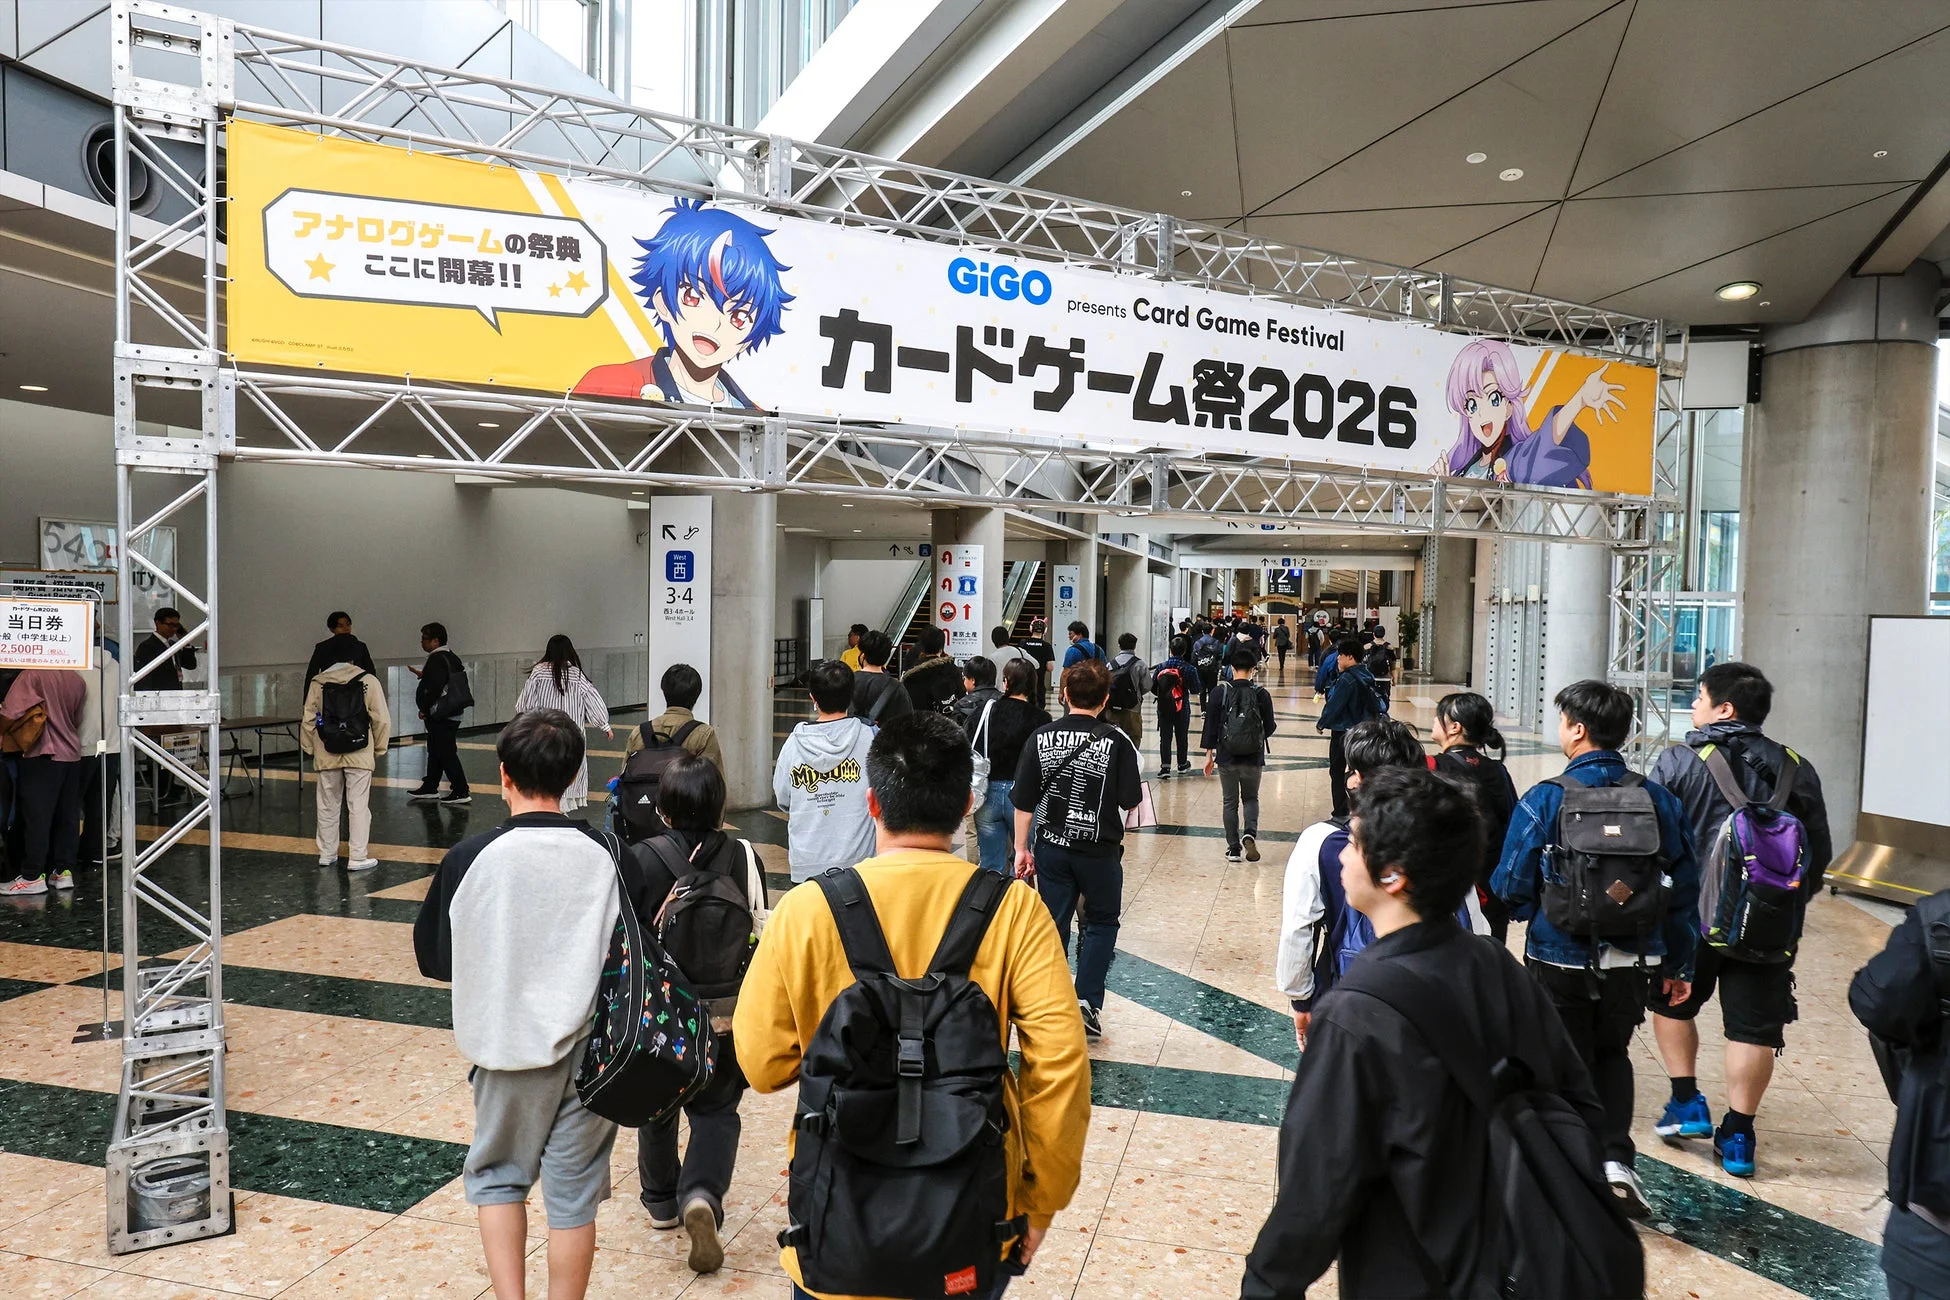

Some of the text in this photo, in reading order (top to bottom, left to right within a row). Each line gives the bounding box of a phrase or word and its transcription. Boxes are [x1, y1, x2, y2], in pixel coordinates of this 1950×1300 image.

[292, 210, 582, 262] アナログゲームの祭典
[364, 253, 522, 289] ここに開幕!!
[948, 257, 1345, 352] GiGO presents Card Game Festival
[819, 308, 1418, 449] カードゲーム祭2026
[673, 562, 686, 579] 西
[8, 614, 64, 631] 当日券
[1037, 731, 1055, 750] PAY
